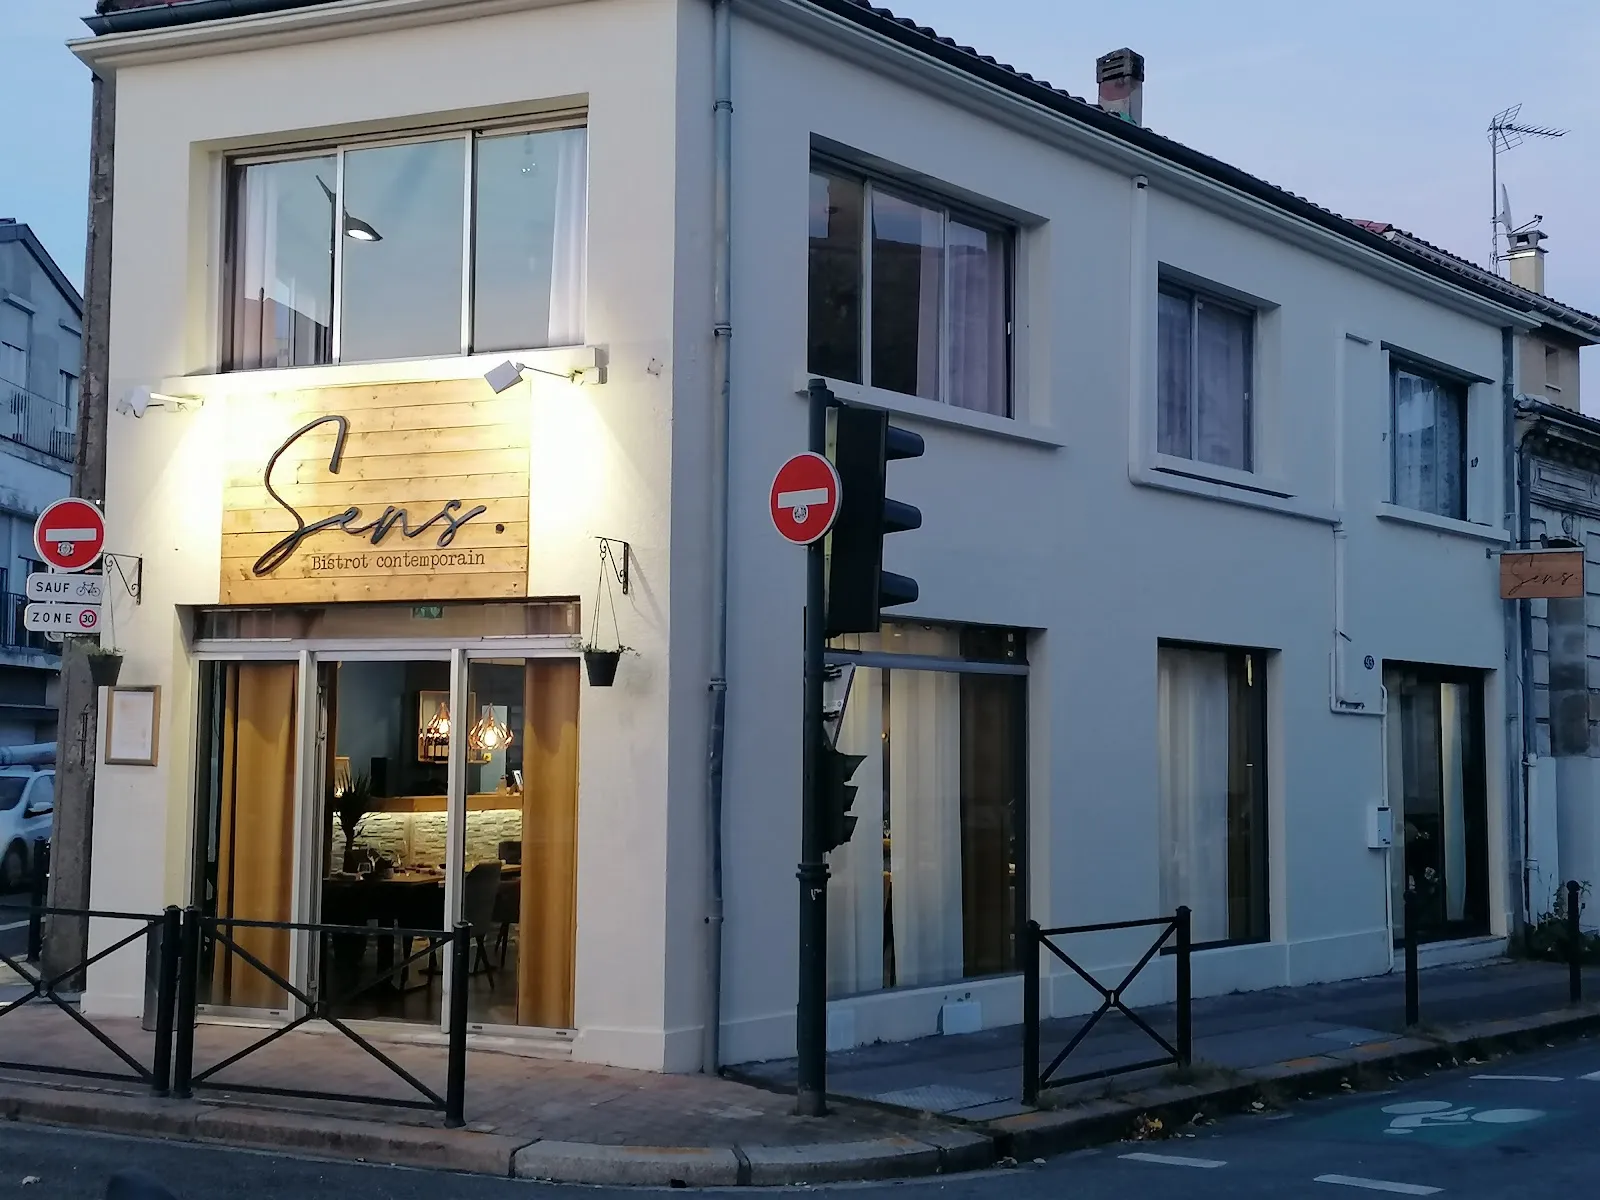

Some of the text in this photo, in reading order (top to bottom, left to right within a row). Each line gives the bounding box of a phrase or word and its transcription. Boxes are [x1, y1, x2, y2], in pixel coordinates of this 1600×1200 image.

[311, 549, 486, 571] Bistrot contemporain
[36, 581, 70, 593] SAUF
[32, 612, 94, 623] ZONE 30
